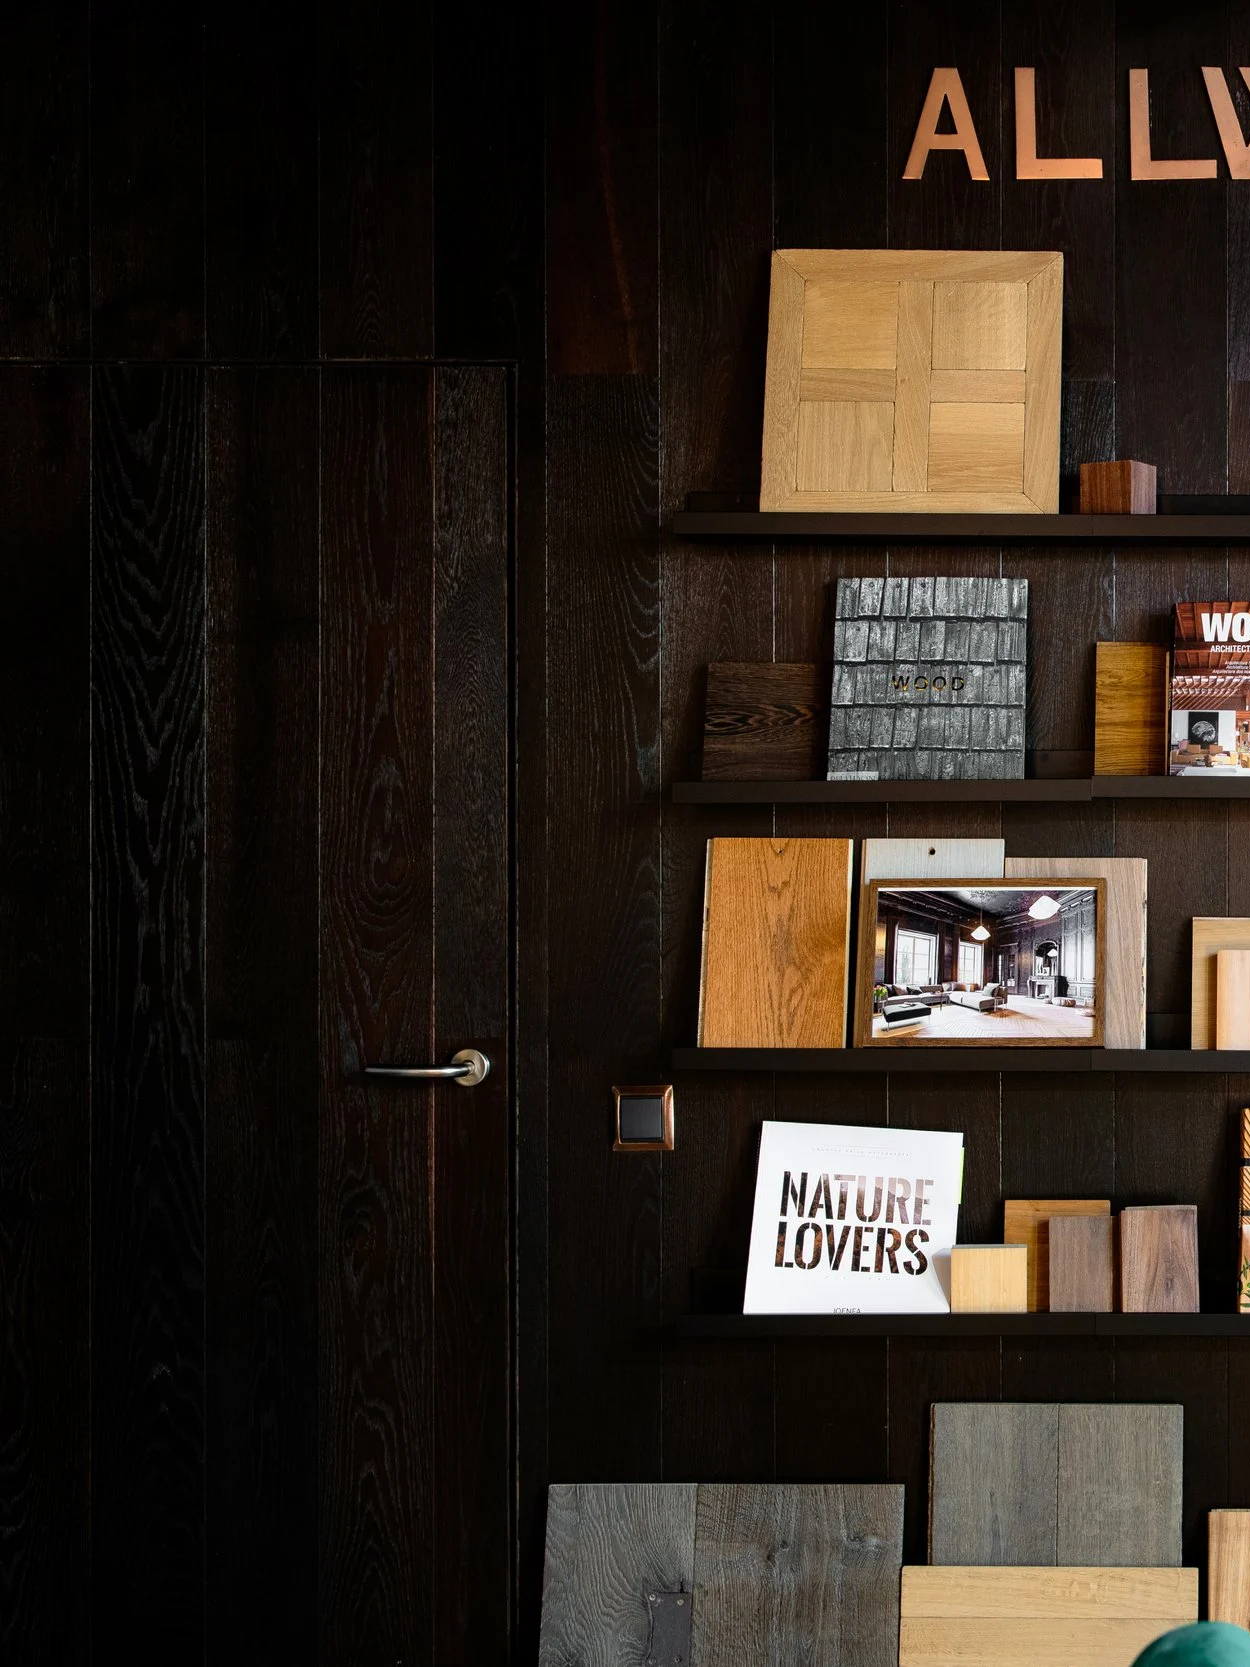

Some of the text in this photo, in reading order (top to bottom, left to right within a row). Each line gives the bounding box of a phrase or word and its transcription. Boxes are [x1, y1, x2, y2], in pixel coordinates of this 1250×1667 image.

[891, 675, 966, 691] WOOD
[780, 1171, 934, 1225] NATURE
[774, 1221, 930, 1276] LOVERS
